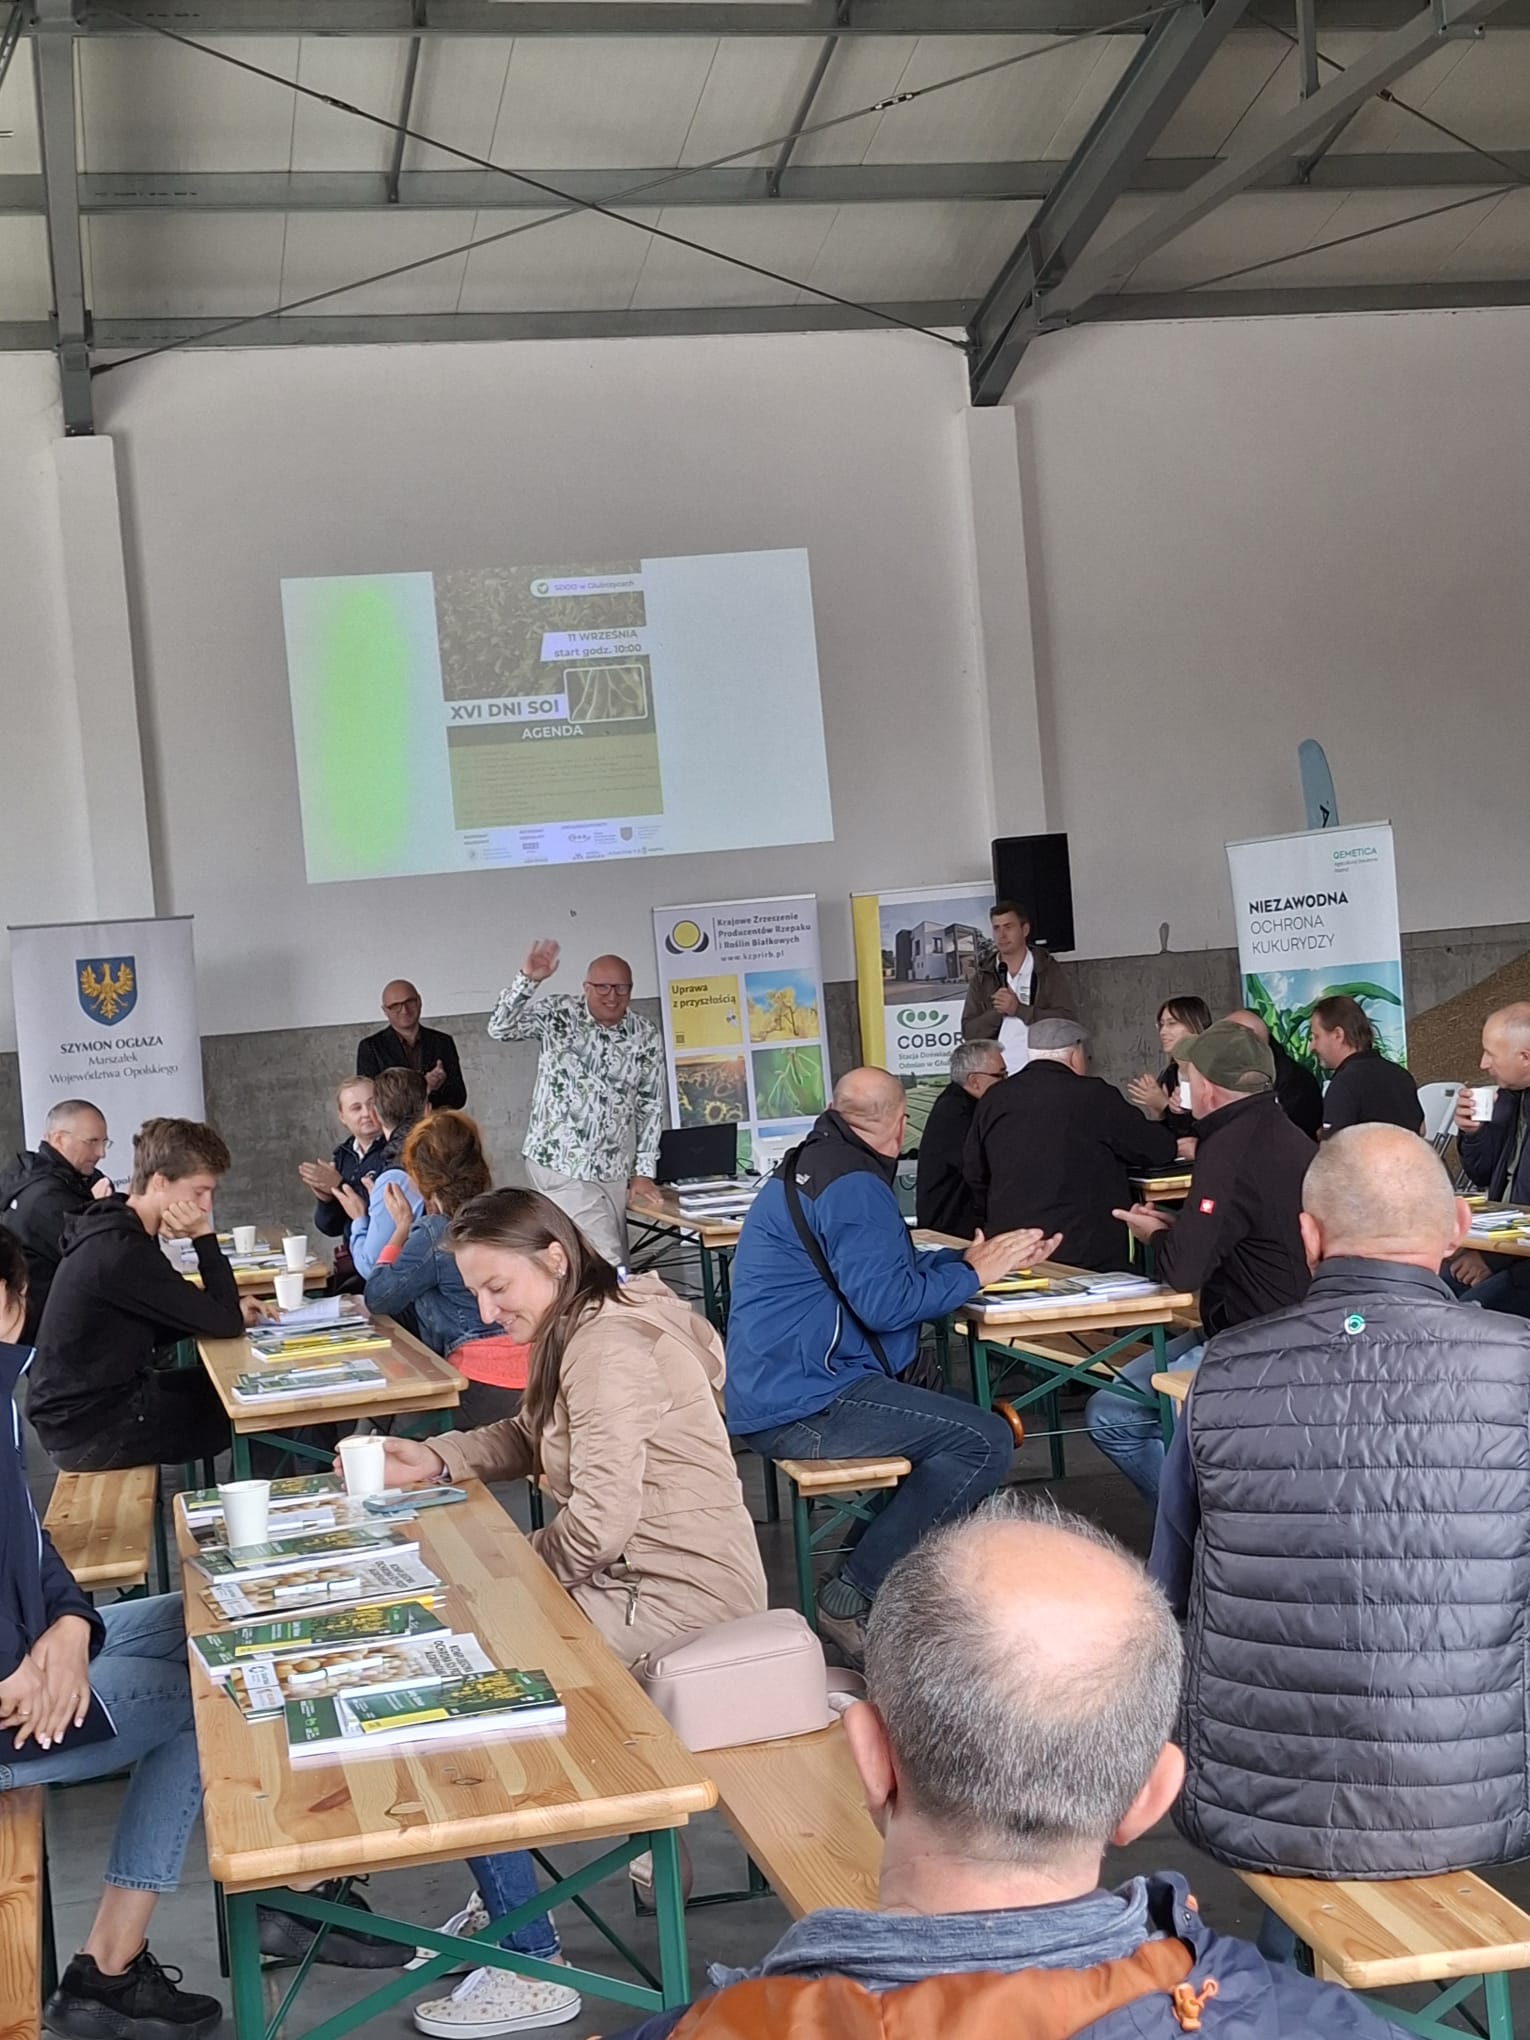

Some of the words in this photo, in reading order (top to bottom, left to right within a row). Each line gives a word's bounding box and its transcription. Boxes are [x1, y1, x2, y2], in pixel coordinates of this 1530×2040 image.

[568, 633, 576, 642] 11
[579, 629, 638, 641] WRZEŚNIA
[554, 648, 580, 658] start
[582, 645, 612, 657] godz.
[613, 643, 642, 654] 10:00
[451, 704, 482, 720] XVI
[488, 701, 522, 717] DNI
[527, 699, 559, 715] SOI
[521, 724, 584, 740] AGENDA
[1333, 848, 1377, 859] QEMETICA
[1249, 891, 1349, 915] NIEZAWODNA
[717, 917, 751, 927] Krajowe
[753, 912, 798, 923] Zrzeszenie
[1250, 915, 1325, 935] OCHRONA
[718, 926, 773, 938] Producentów
[775, 923, 811, 933] Rzepaku
[724, 939, 750, 949] Roślin
[752, 935, 800, 946] Białkowych
[1252, 934, 1335, 955] KUKURYDZY
[671, 984, 708, 996] Uprawa
[673, 1000, 678, 1008] z
[679, 993, 737, 1009] przyszłością
[60, 1040, 112, 1054] SZYMON
[116, 1036, 164, 1049] OGŁAZA
[897, 1031, 962, 1049] COBOR
[88, 1052, 138, 1065] Marszałek
[49, 1070, 121, 1085] Województwa
[123, 1064, 178, 1079] Opolskiego
